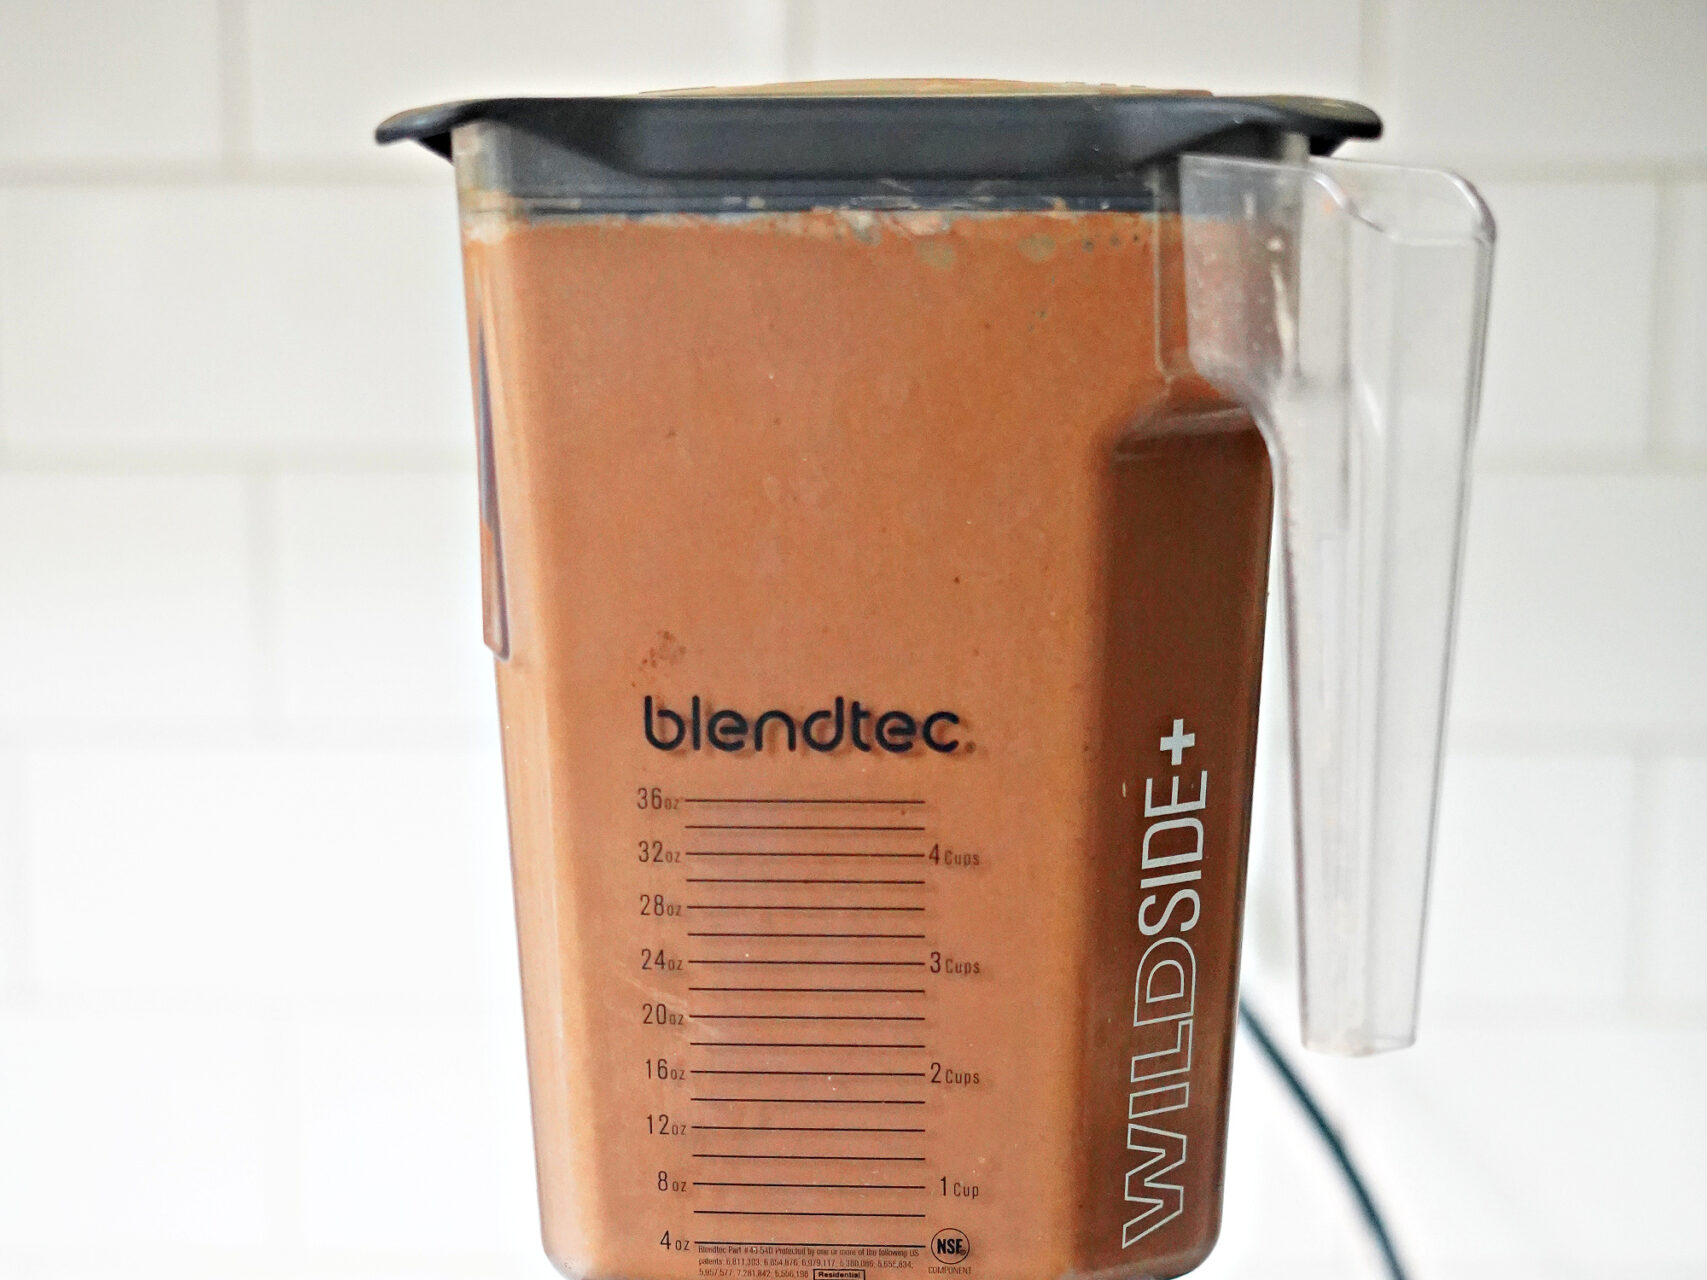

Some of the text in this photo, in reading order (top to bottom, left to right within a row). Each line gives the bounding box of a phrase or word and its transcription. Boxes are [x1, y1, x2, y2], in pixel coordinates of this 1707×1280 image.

[644, 695, 959, 753] blendtec
[929, 843, 980, 869] 4 Cups
[930, 951, 981, 976] 3 Cups
[930, 1062, 980, 1086] 2 Cups
[940, 1176, 980, 1200] 1 Cup
[818, 1271, 861, 1279] Residential
